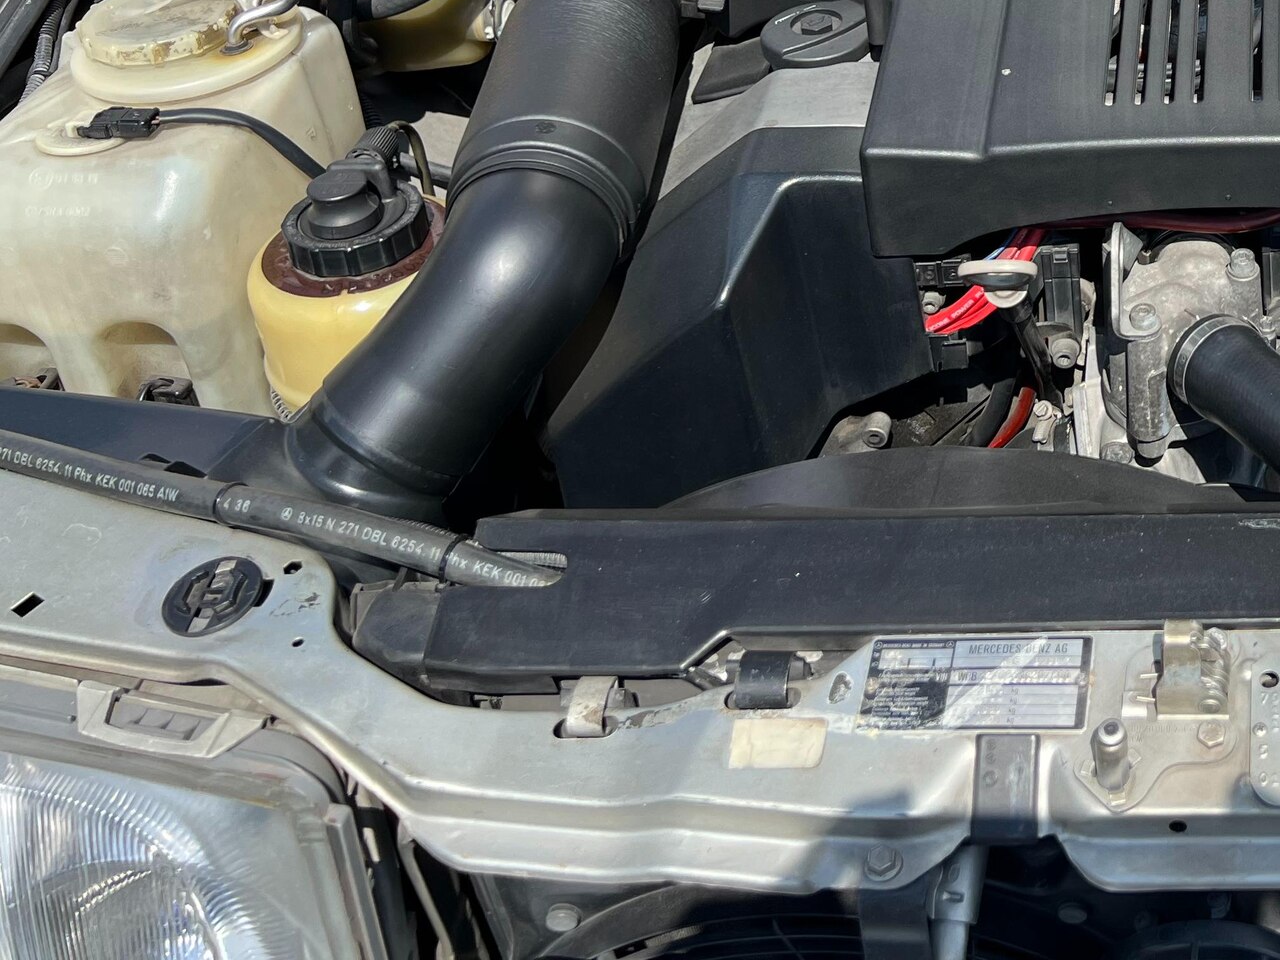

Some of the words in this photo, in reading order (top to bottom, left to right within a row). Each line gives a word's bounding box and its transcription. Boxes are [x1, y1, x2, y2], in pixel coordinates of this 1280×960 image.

[0, 446, 11, 461] 71
[14, 451, 33, 468] DBL
[74, 466, 92, 483] Phx
[95, 473, 118, 489] KEK
[118, 478, 135, 494] 001
[338, 521, 359, 537] 271
[361, 527, 388, 546] DBL
[473, 560, 503, 581] KEK
[968, 642, 1051, 655] MERCEDESBENZ
[1054, 642, 1069, 654] AG
